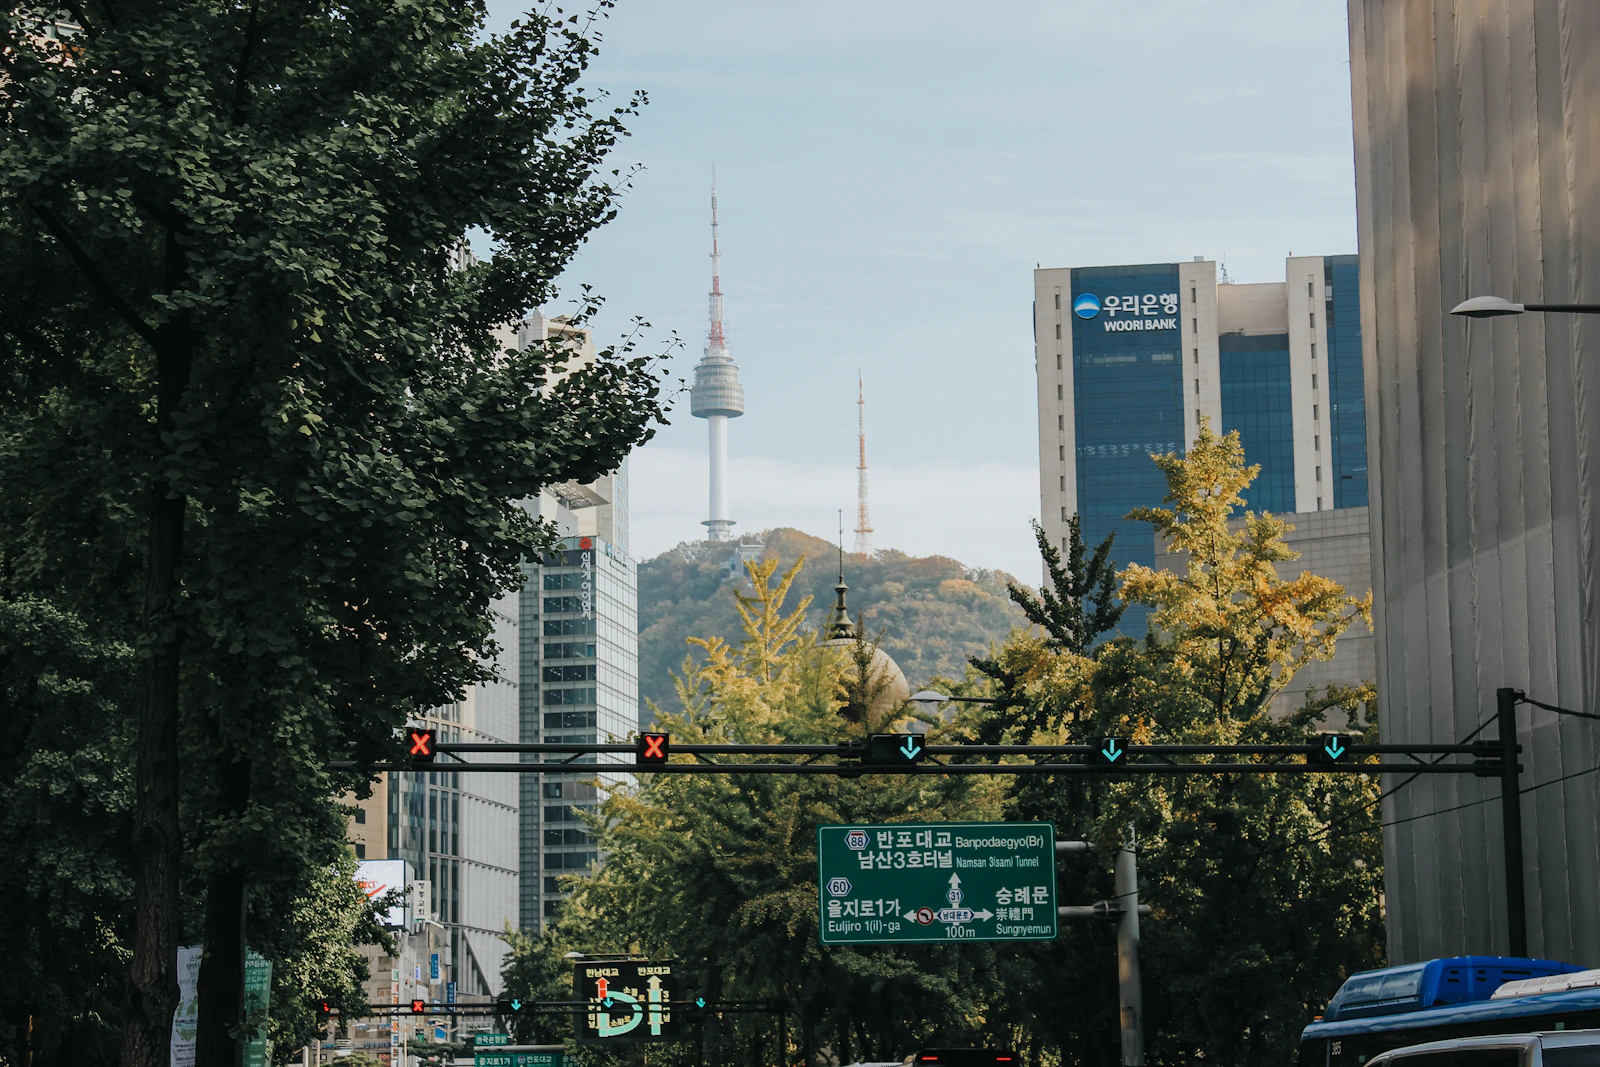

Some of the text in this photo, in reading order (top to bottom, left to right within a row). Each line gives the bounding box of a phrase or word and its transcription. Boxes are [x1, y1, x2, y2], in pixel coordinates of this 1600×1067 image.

[1103, 293, 1178, 317] 우리은행
[1104, 318, 1177, 332] WOORI BANK
[581, 551, 591, 620] 신세계아이앤씨
[851, 836, 864, 847] 88
[876, 830, 952, 849] 반포대교
[956, 835, 1044, 850] Banpodaegyo(Br)
[857, 850, 953, 869] 남산3호터널
[956, 855, 1039, 868] Namsan 3(sam) Tunnel
[833, 881, 846, 893] 60
[950, 891, 960, 901] 31
[996, 886, 1049, 905] 숭례문
[827, 898, 901, 918] 을지로1가
[942, 910, 969, 920] 남대문로
[996, 907, 1034, 921] 崇禮門
[828, 920, 901, 934] Euljiro 1(il)-ga
[945, 926, 976, 938] 100m
[996, 923, 1051, 937] Sungnyemun
[638, 966, 671, 976] 반포대교
